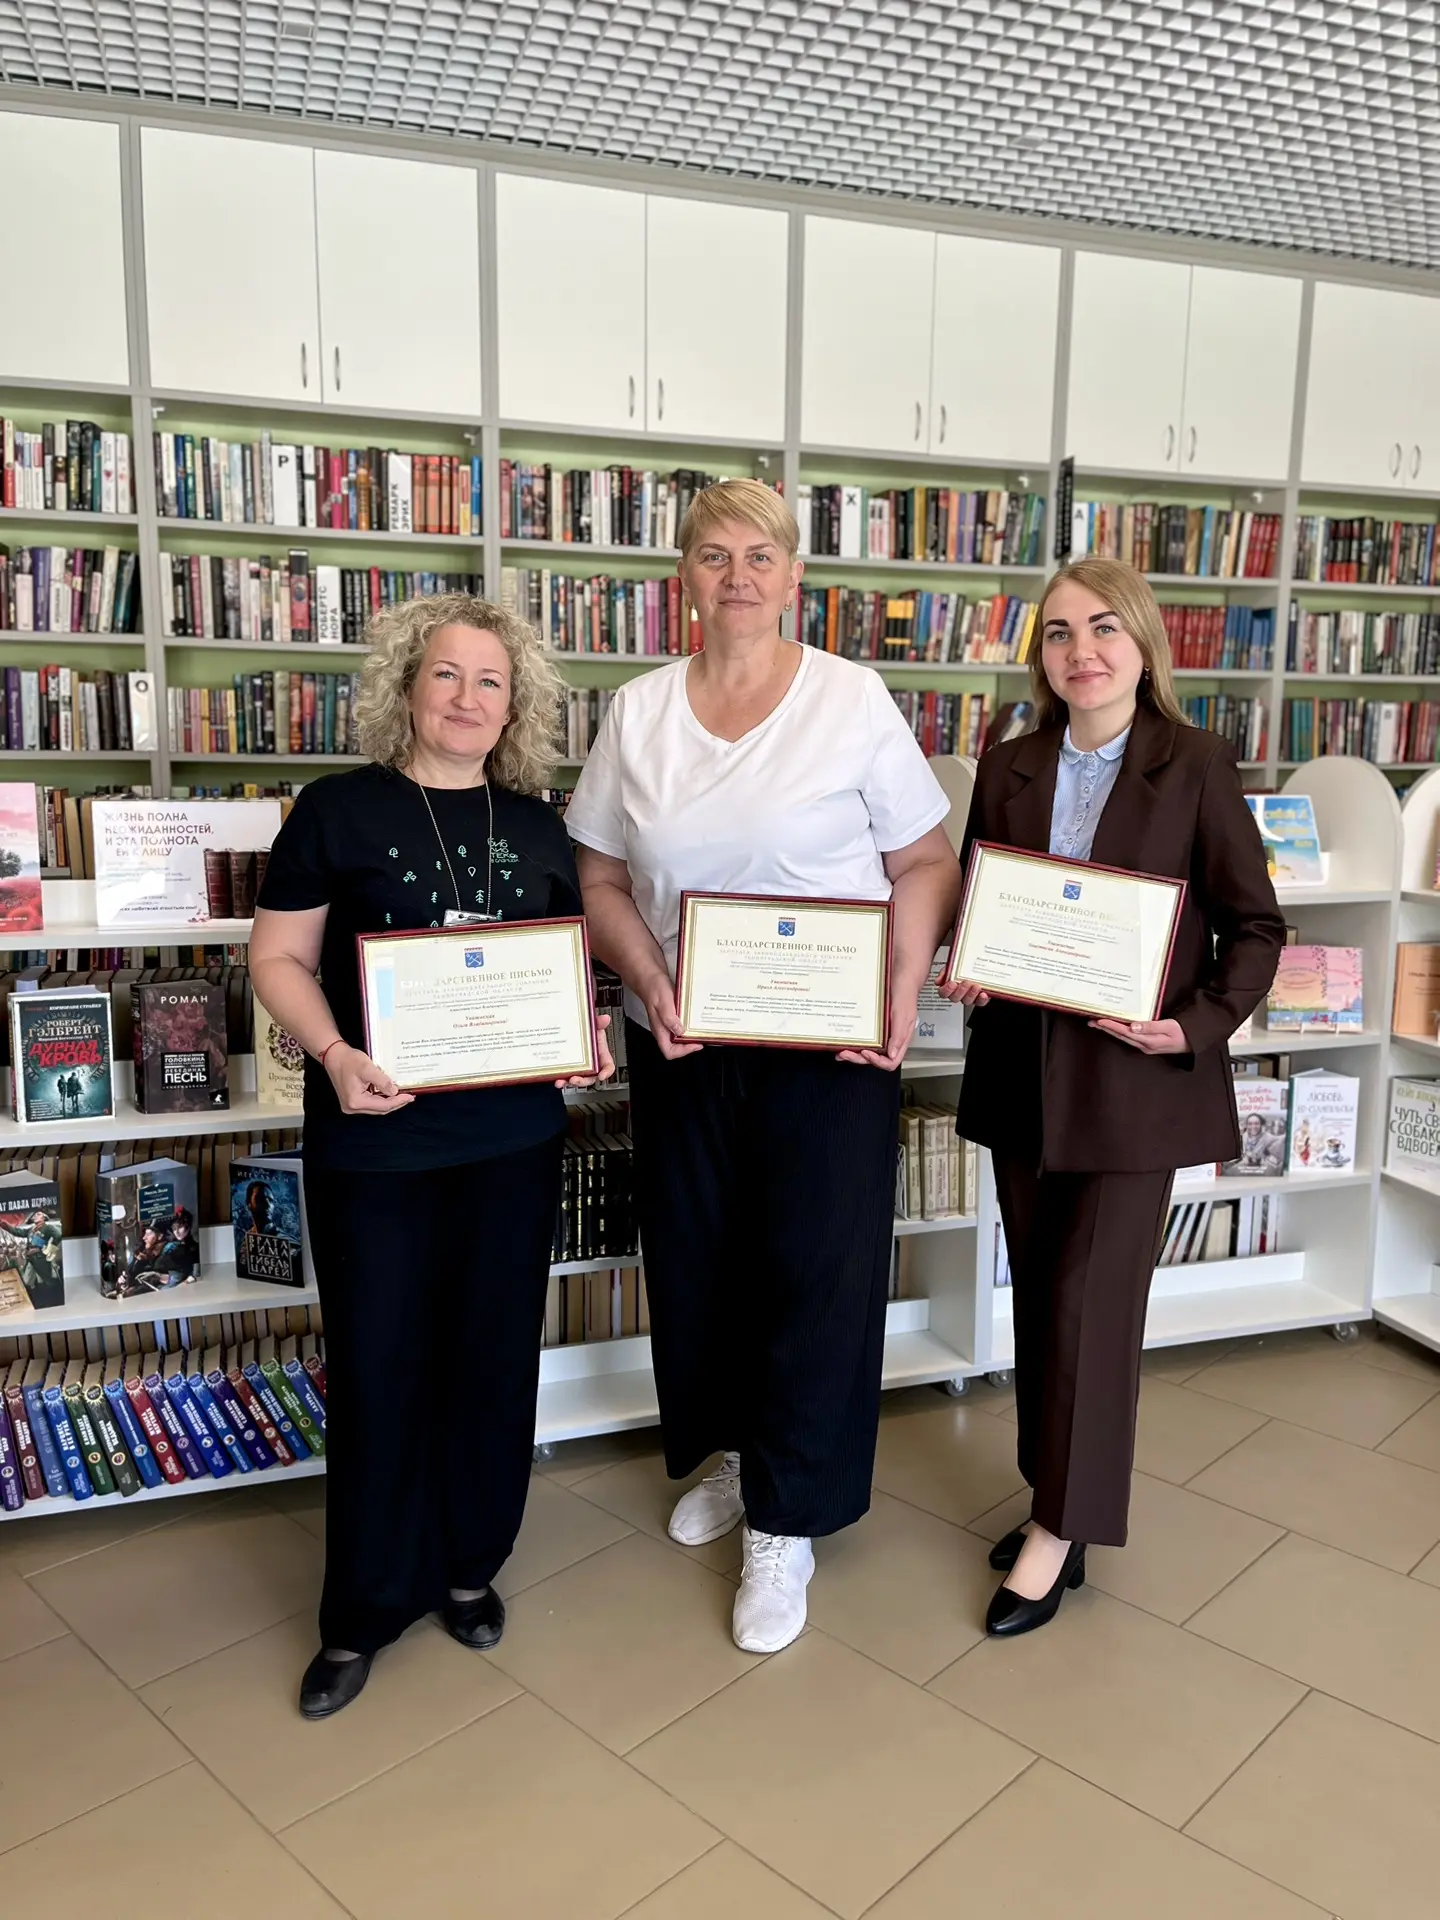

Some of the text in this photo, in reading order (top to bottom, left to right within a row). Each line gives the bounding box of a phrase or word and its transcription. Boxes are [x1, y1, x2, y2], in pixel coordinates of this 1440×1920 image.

[402, 499, 410, 530] ЭРИХ
[320, 586, 328, 639] РОБЕРТС
[105, 812, 188, 822] ЖИЗНЬ ПОЛНА
[105, 836, 199, 846] И ЭТА ПОЛНОТА
[142, 847, 172, 857] ЛИЦУ
[999, 892, 1097, 917] БЛАГОДАРСТВЕННОЕ
[716, 939, 857, 954] БЛАГОДАРСТВЕННОЕ ПИСЬМО
[509, 968, 553, 980] ПИСЬМО
[161, 996, 208, 1004] РОМАН
[47, 1019, 83, 1028] РОБЕРТ
[28, 1024, 102, 1038] ГЭЛБРЕЙТ
[29, 1039, 99, 1056] ДУРНАЯ
[39, 1050, 102, 1068] КРОВЬ
[164, 1072, 207, 1084] ПЕСНЬ
[281, 1091, 304, 1099] веще
[1248, 1096, 1264, 1104] 100
[1394, 1105, 1440, 1128] ЧУТЬ СВ
[1389, 1119, 1397, 1133] С
[8, 1199, 30, 1211] ПАВЛА
[31, 1196, 57, 1208] ПЕРВОГО
[248, 1235, 288, 1249] ВРАТА
[249, 1244, 289, 1258] РИМА
[250, 1255, 290, 1269] ГИБЕЛЬ
[250, 1264, 291, 1278] ЦАРЕЙ
[303, 1392, 319, 1413] ЛАЗУРЬ
[140, 1411, 156, 1436] МУЗЫКА
[230, 1409, 245, 1430] ОПАСНАЯ
[55, 1422, 69, 1451] НАРЦИСС
[104, 1420, 119, 1446] ВЕДЬМА
